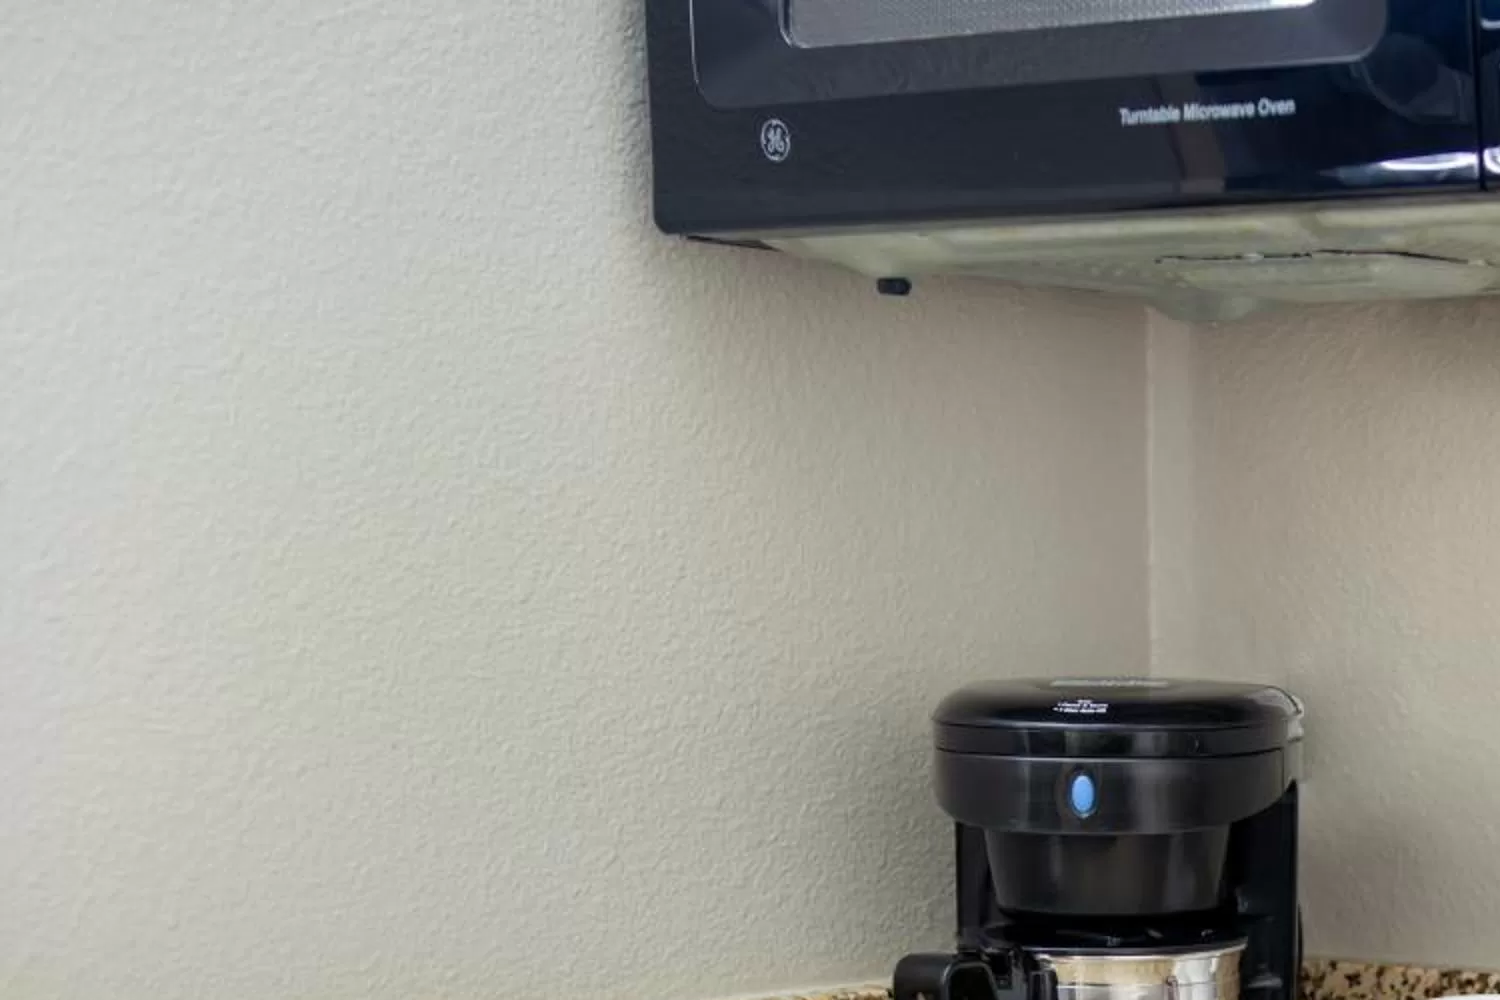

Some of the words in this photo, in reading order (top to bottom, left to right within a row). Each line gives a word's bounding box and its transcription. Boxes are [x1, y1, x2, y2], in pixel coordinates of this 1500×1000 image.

[1118, 104, 1181, 127] Turntable
[1183, 101, 1255, 121] Microwave
[1257, 97, 1297, 116] Oven
